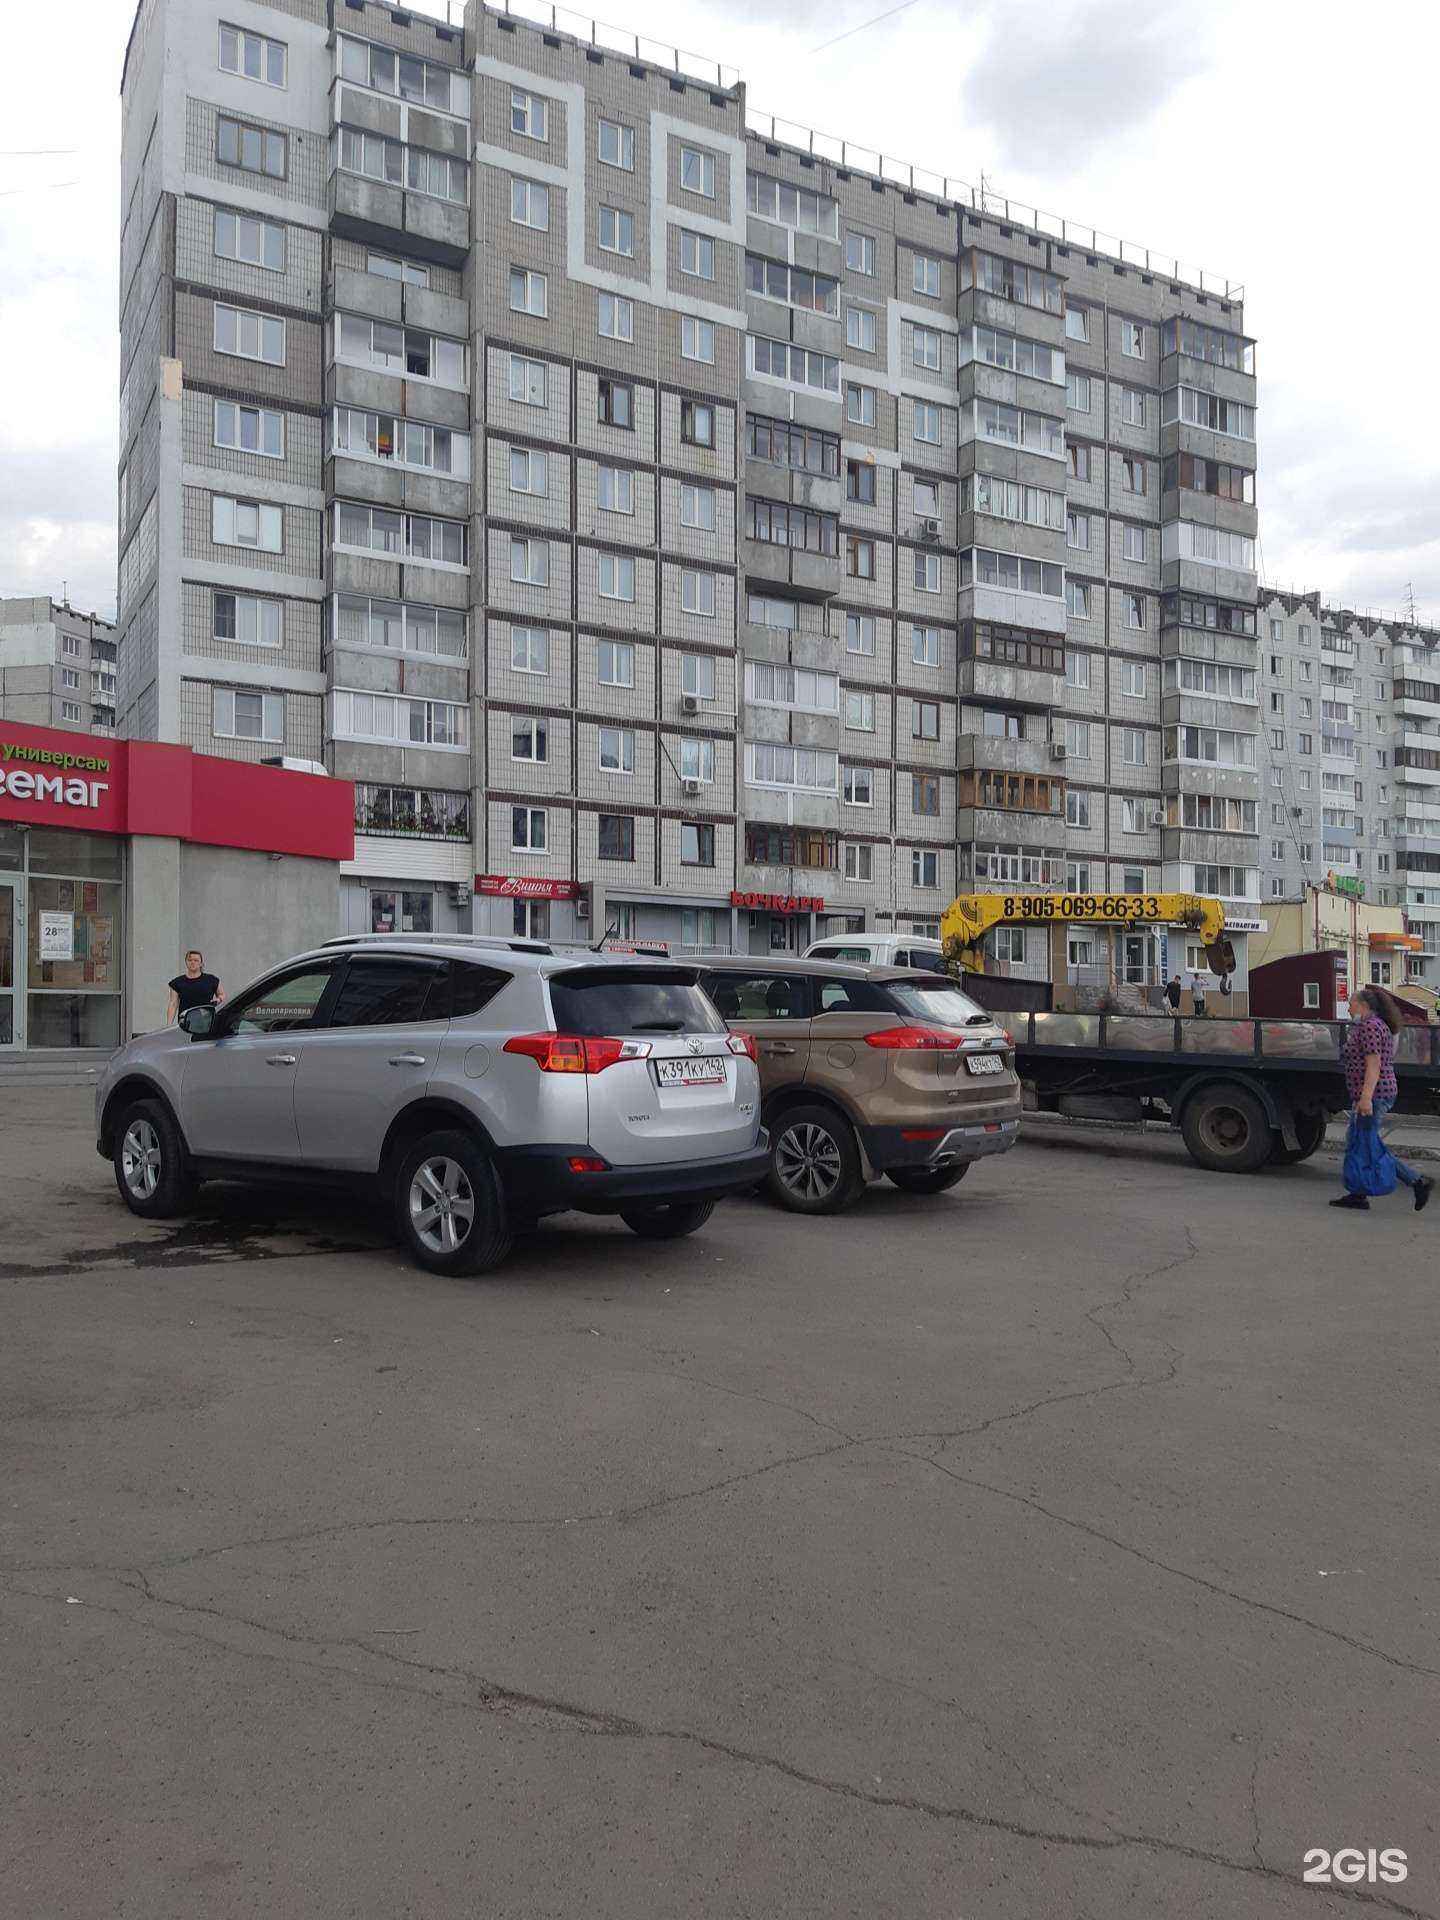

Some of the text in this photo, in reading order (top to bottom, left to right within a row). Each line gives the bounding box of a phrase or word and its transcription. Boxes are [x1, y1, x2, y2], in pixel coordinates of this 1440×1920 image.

[3, 744, 110, 772] универсам
[0, 768, 109, 808] емаг
[501, 878, 553, 894] Вишня
[731, 891, 825, 913] БОЧКАРИ
[1003, 897, 1160, 917] 8-905-069-66-33
